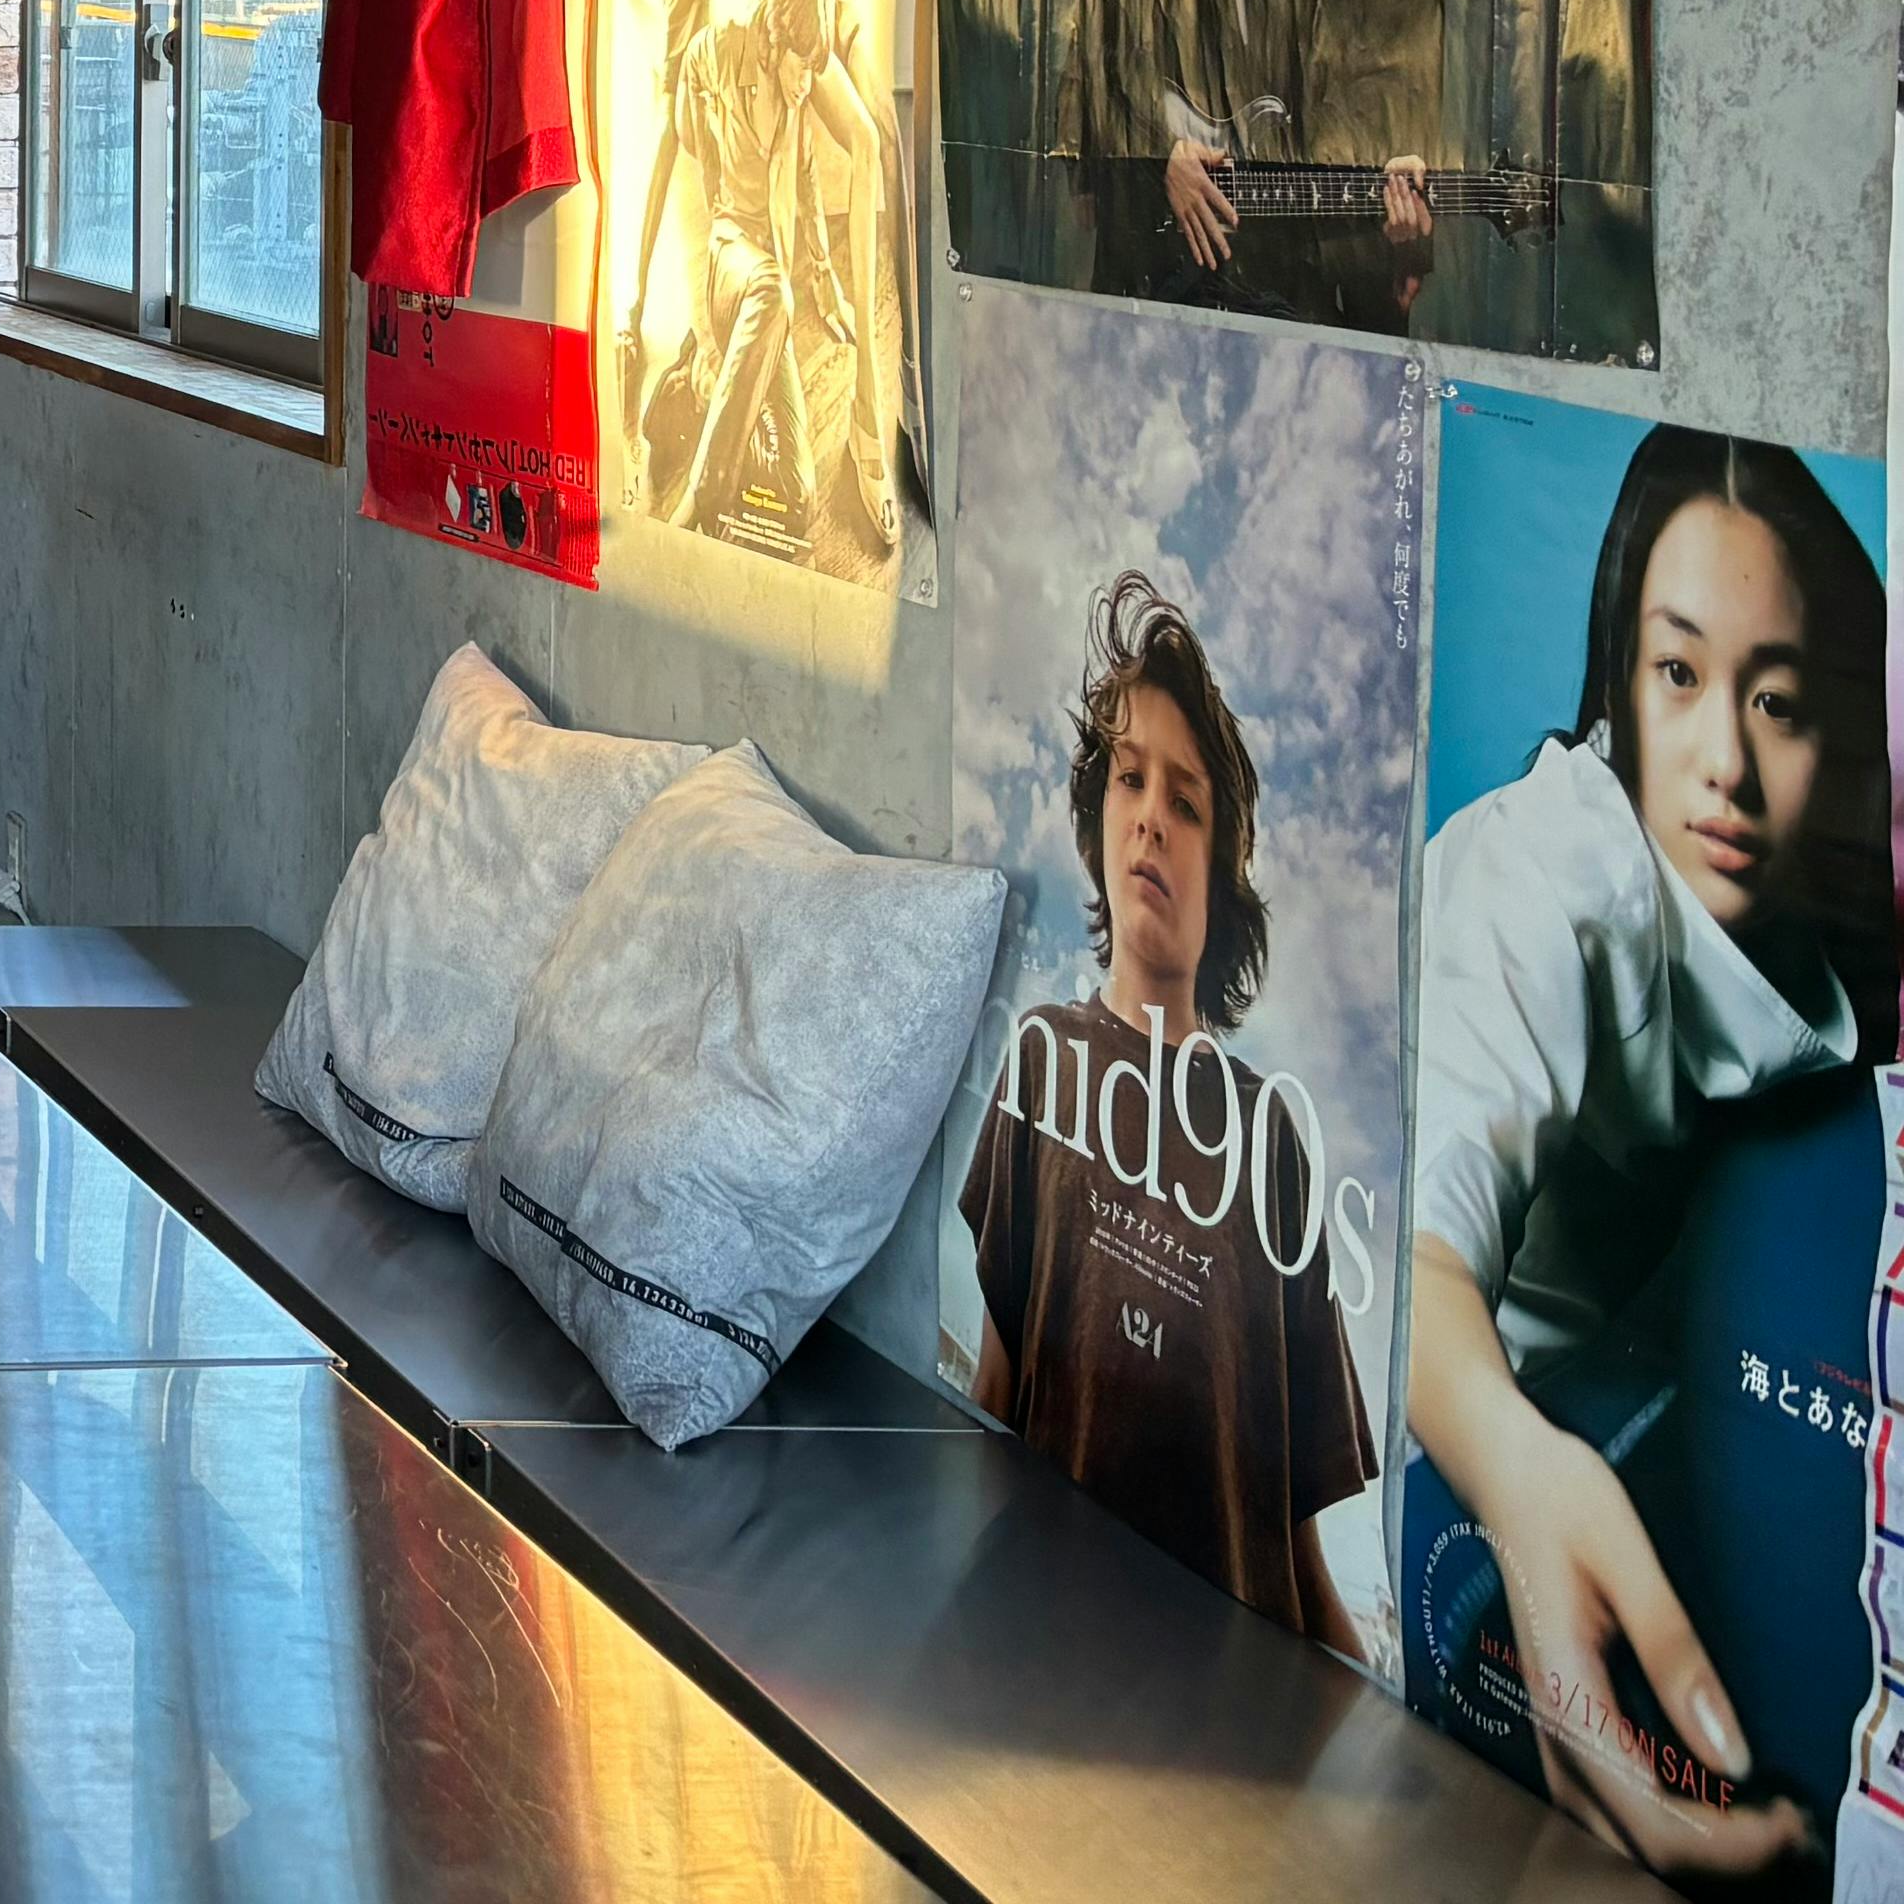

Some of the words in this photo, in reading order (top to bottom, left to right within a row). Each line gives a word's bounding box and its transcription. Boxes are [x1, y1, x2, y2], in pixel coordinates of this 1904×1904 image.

[1391, 384, 1415, 650] たちあがれ、何度でも
[1087, 1188, 1214, 1280] ミッドナインティーズ
[1113, 1299, 1164, 1361] A24
[1548, 1671, 1609, 1736] 3/17
[1617, 1715, 1658, 1777] ON
[1661, 1744, 1736, 1813] SALE
